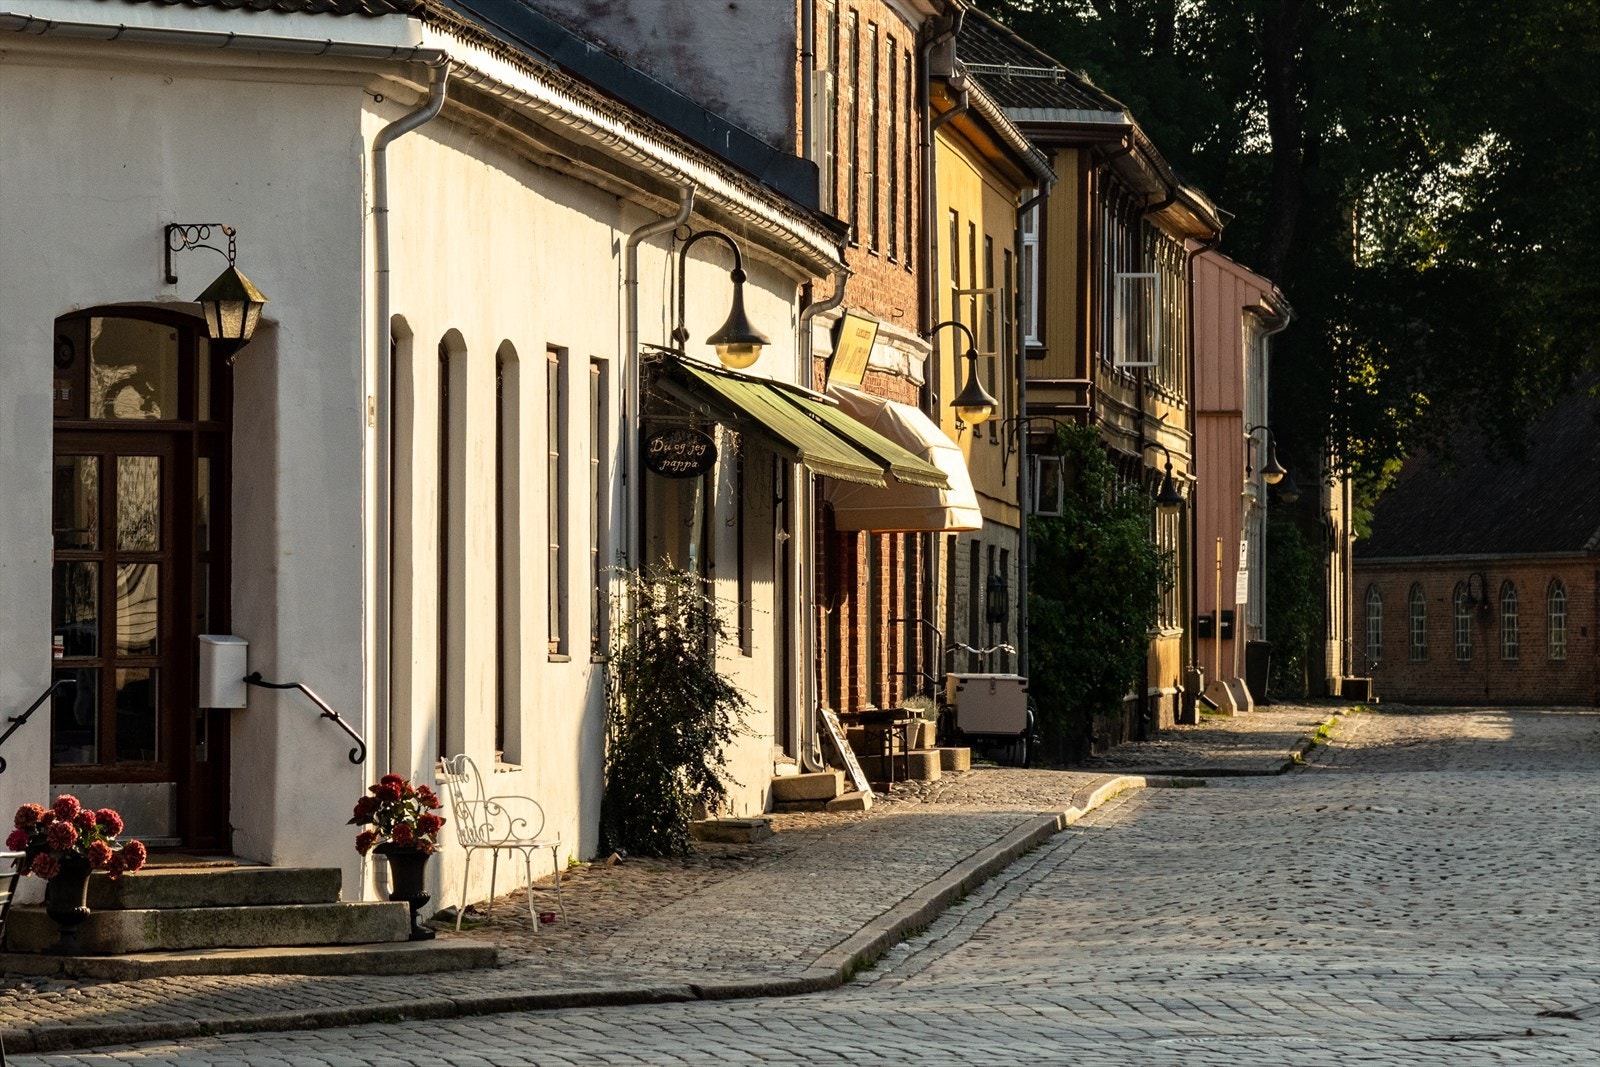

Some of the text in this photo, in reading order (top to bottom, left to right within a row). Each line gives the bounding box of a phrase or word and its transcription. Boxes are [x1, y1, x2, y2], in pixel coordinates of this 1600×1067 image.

[674, 443, 686, 455] og
[687, 440, 707, 456] jeg
[659, 460, 698, 472] pappa
